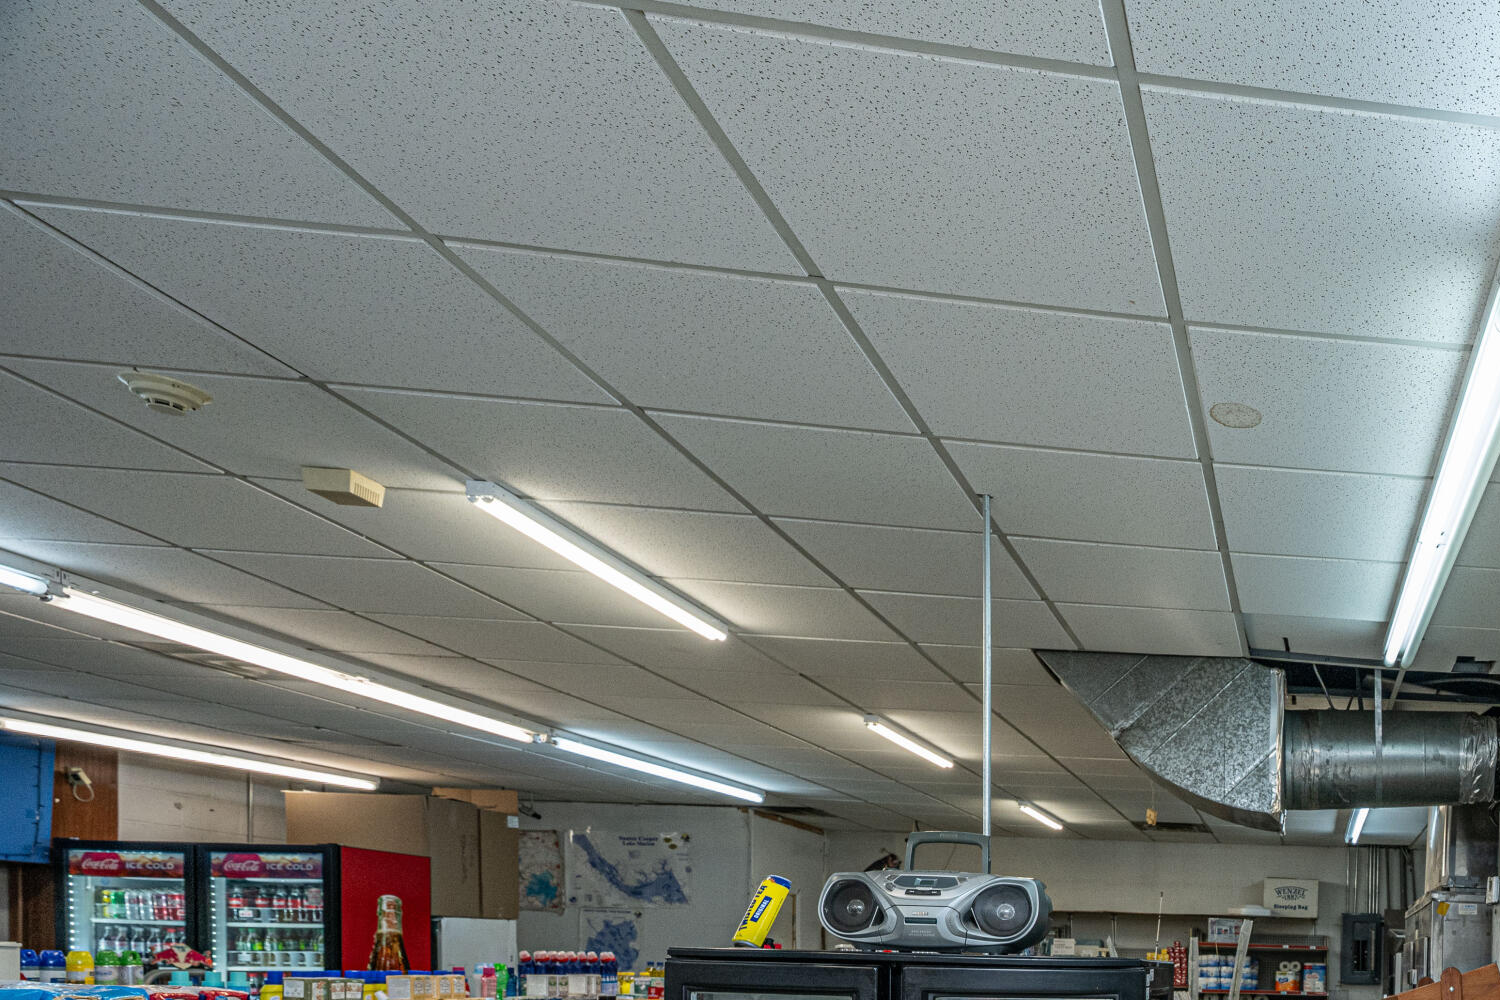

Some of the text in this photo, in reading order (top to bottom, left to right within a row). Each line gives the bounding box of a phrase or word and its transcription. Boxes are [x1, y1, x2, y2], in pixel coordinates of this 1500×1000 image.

[81, 858, 175, 870] Coca-Cola ICE COLD
[224, 859, 313, 872] Coca-Cola ICE COLD
